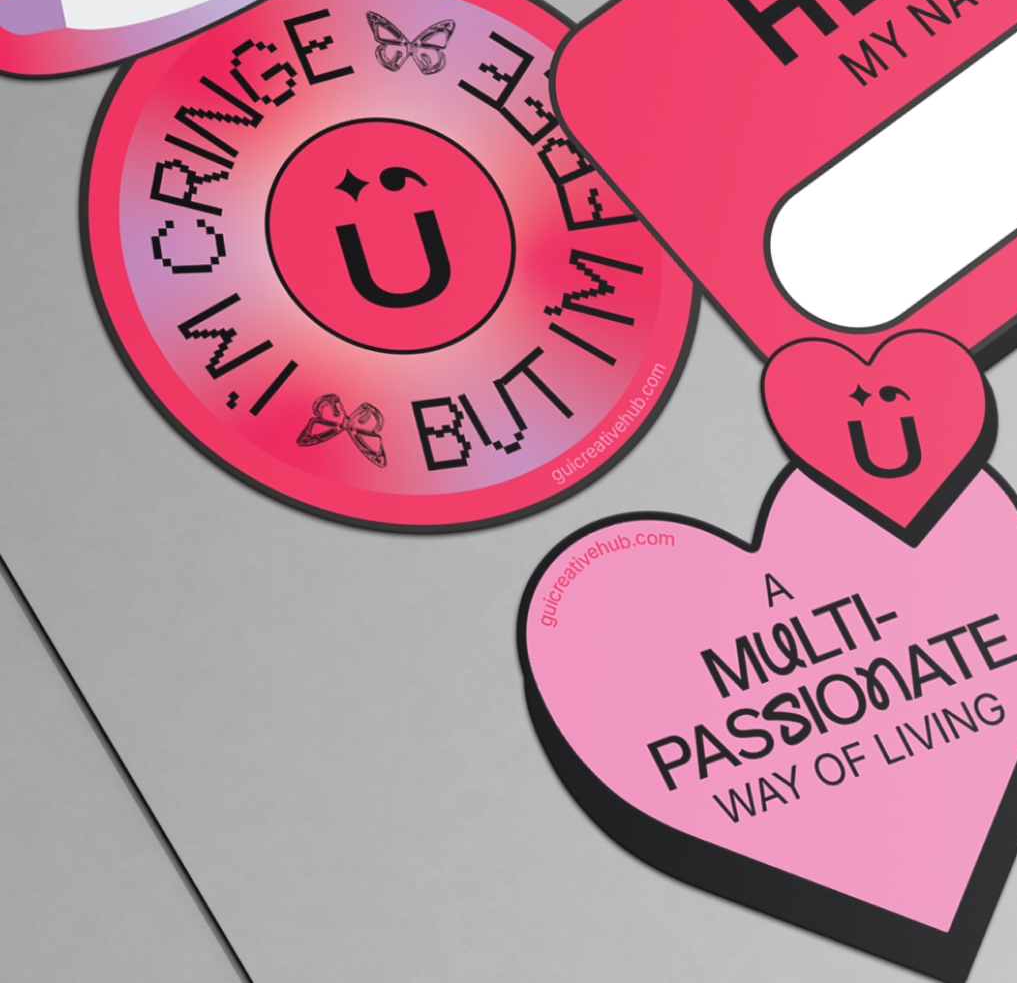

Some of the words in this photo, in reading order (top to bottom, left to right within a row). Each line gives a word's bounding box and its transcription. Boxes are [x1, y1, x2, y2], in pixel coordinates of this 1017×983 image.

[838, 20, 910, 88] MY
[150, 8, 356, 275] CRINGE
[410, 346, 575, 472] BUT
[549, 360, 668, 486] guicreativehub.com
[540, 530, 677, 630] guicreativehub.com
[763, 571, 795, 608] A
[699, 592, 900, 700] MULTI-
[712, 764, 803, 824] WAY
[813, 741, 868, 787] OF
[873, 691, 1007, 765] LIVING
